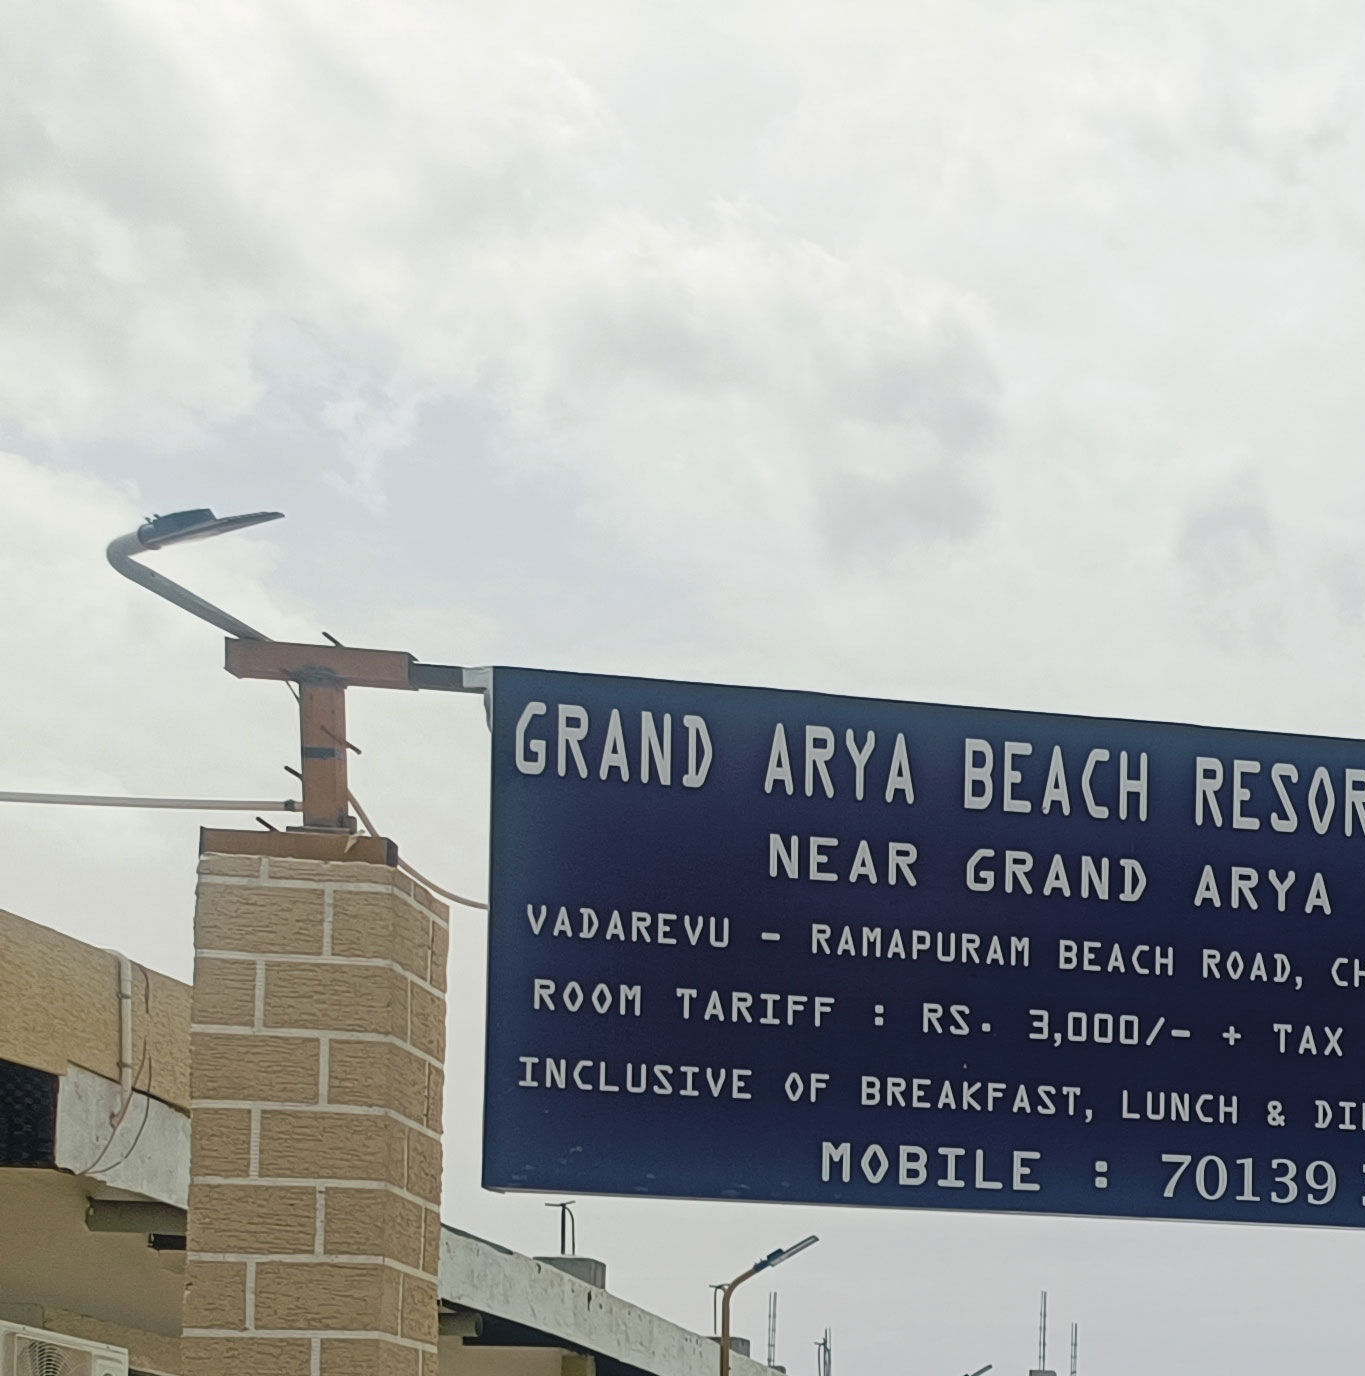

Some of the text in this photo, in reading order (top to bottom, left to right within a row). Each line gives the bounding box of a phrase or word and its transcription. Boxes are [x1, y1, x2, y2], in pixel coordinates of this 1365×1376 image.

[516, 702, 712, 787] GRAND
[765, 723, 914, 804] ARYA
[964, 738, 1147, 821] BEACH
[770, 833, 917, 886] NEAR
[967, 849, 1146, 901] GRAND
[1194, 865, 1331, 915] ARYA
[527, 904, 729, 947] VADAREVU
[761, 932, 780, 940] -
[812, 924, 1029, 966] RAMAPURAM
[1059, 940, 1173, 975] BEACH
[1203, 949, 1302, 990] ROAD,
[534, 979, 641, 1016] ROOM
[676, 988, 835, 1027] TARIFF
[875, 1005, 884, 1025] :
[923, 1003, 990, 1035] RS.
[1029, 1009, 1191, 1047] 3,000/-
[1223, 1026, 1241, 1045] +
[1273, 1024, 1343, 1056] TAX
[519, 1056, 752, 1099] INCLUSIVE
[785, 1072, 829, 1102] OF
[862, 1076, 1092, 1122] BREAKFAST,
[1123, 1090, 1239, 1125] LUNCH
[1268, 1101, 1285, 1126] &
[822, 1142, 1040, 1190] MOBILE
[1095, 1161, 1107, 1188] :
[1162, 1154, 1336, 1204] 70139
